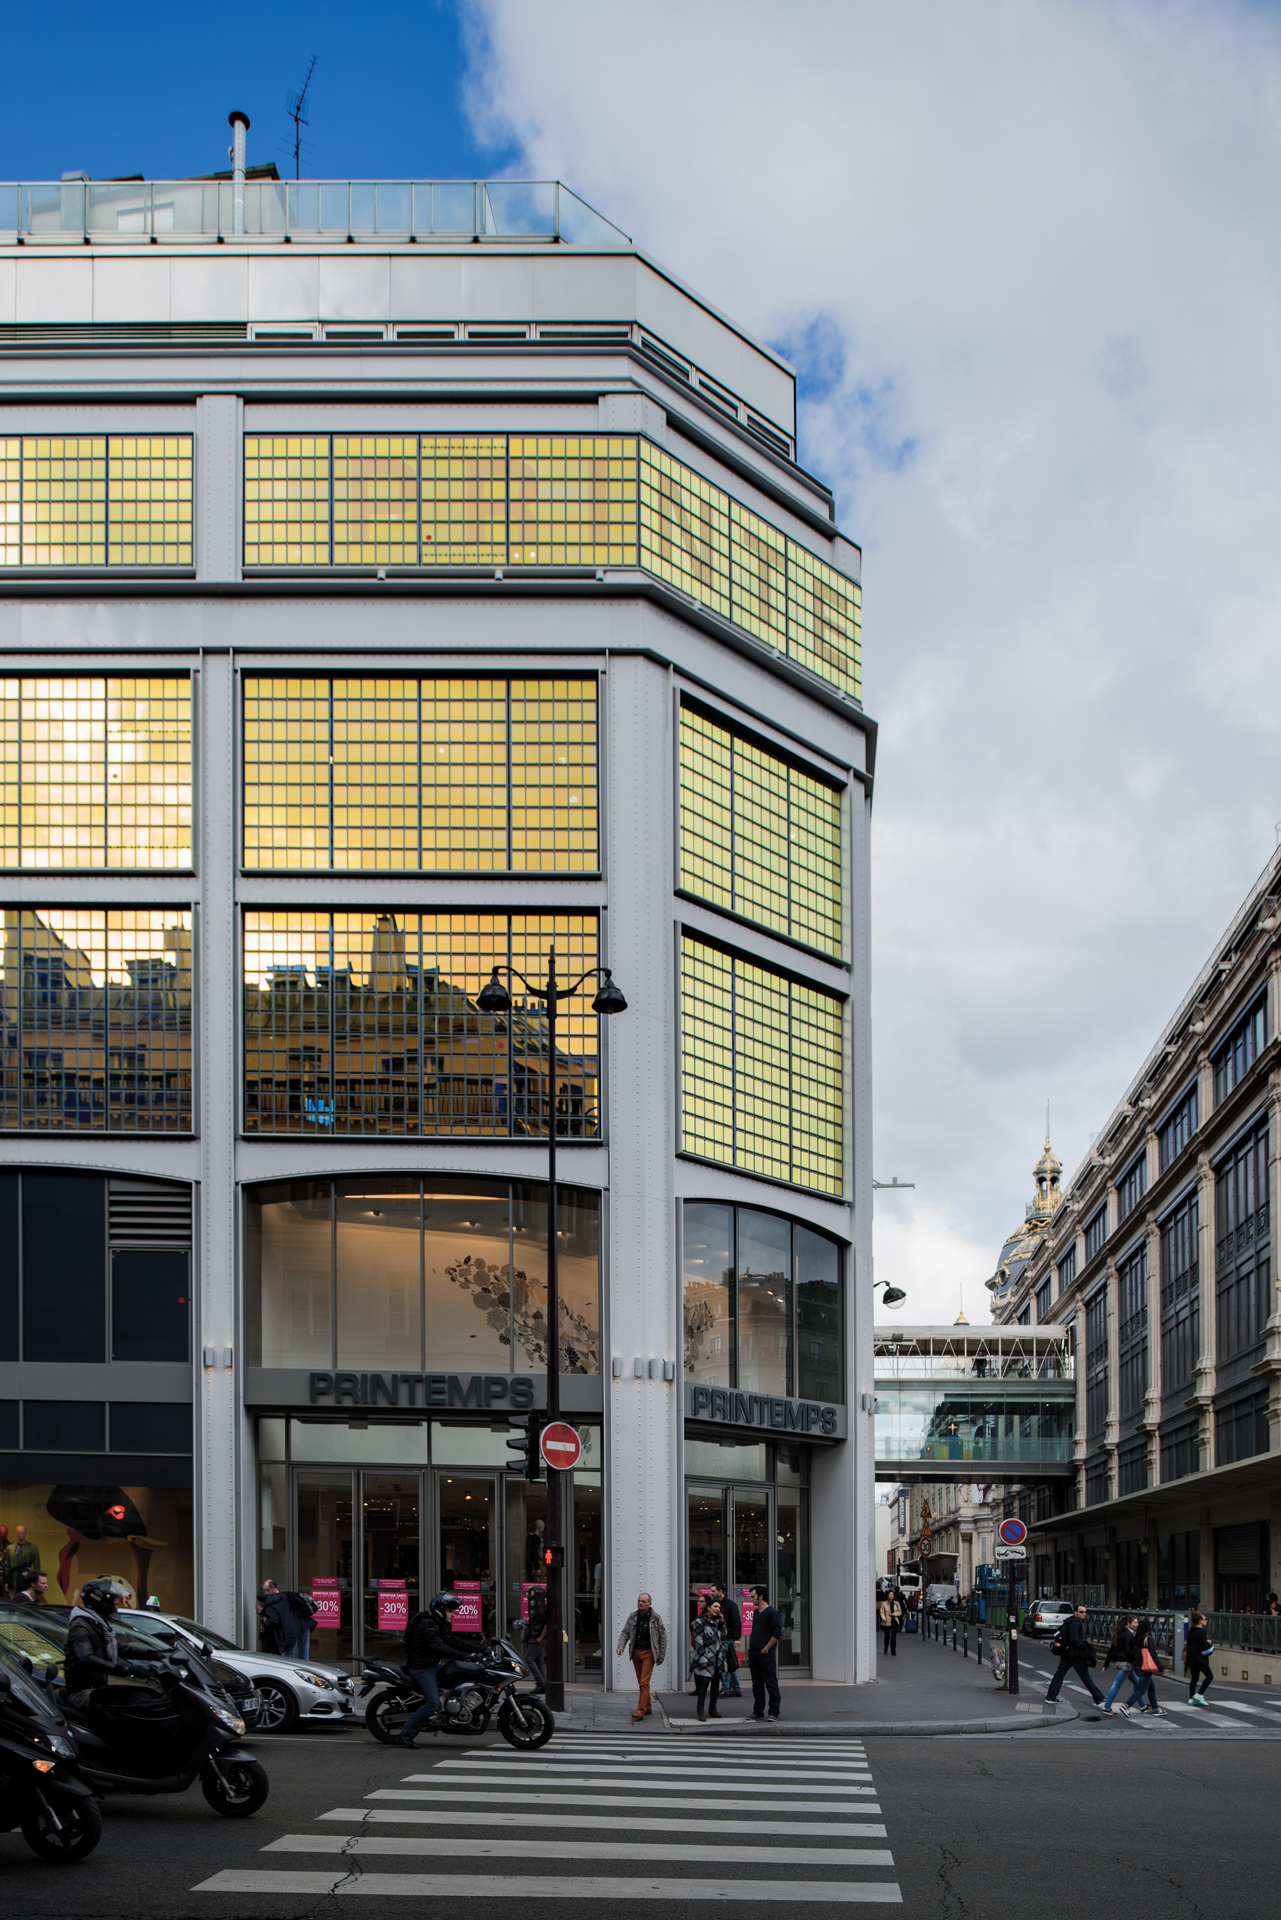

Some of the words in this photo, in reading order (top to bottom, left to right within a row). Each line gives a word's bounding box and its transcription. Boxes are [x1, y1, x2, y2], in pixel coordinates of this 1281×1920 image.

[309, 1372, 535, 1408] PRINTEMPS
[692, 1386, 837, 1434] PRINTEMPS
[922, 1542, 930, 1552] 30
[380, 1602, 407, 1614] -30%
[455, 1604, 478, 1615] -20%
